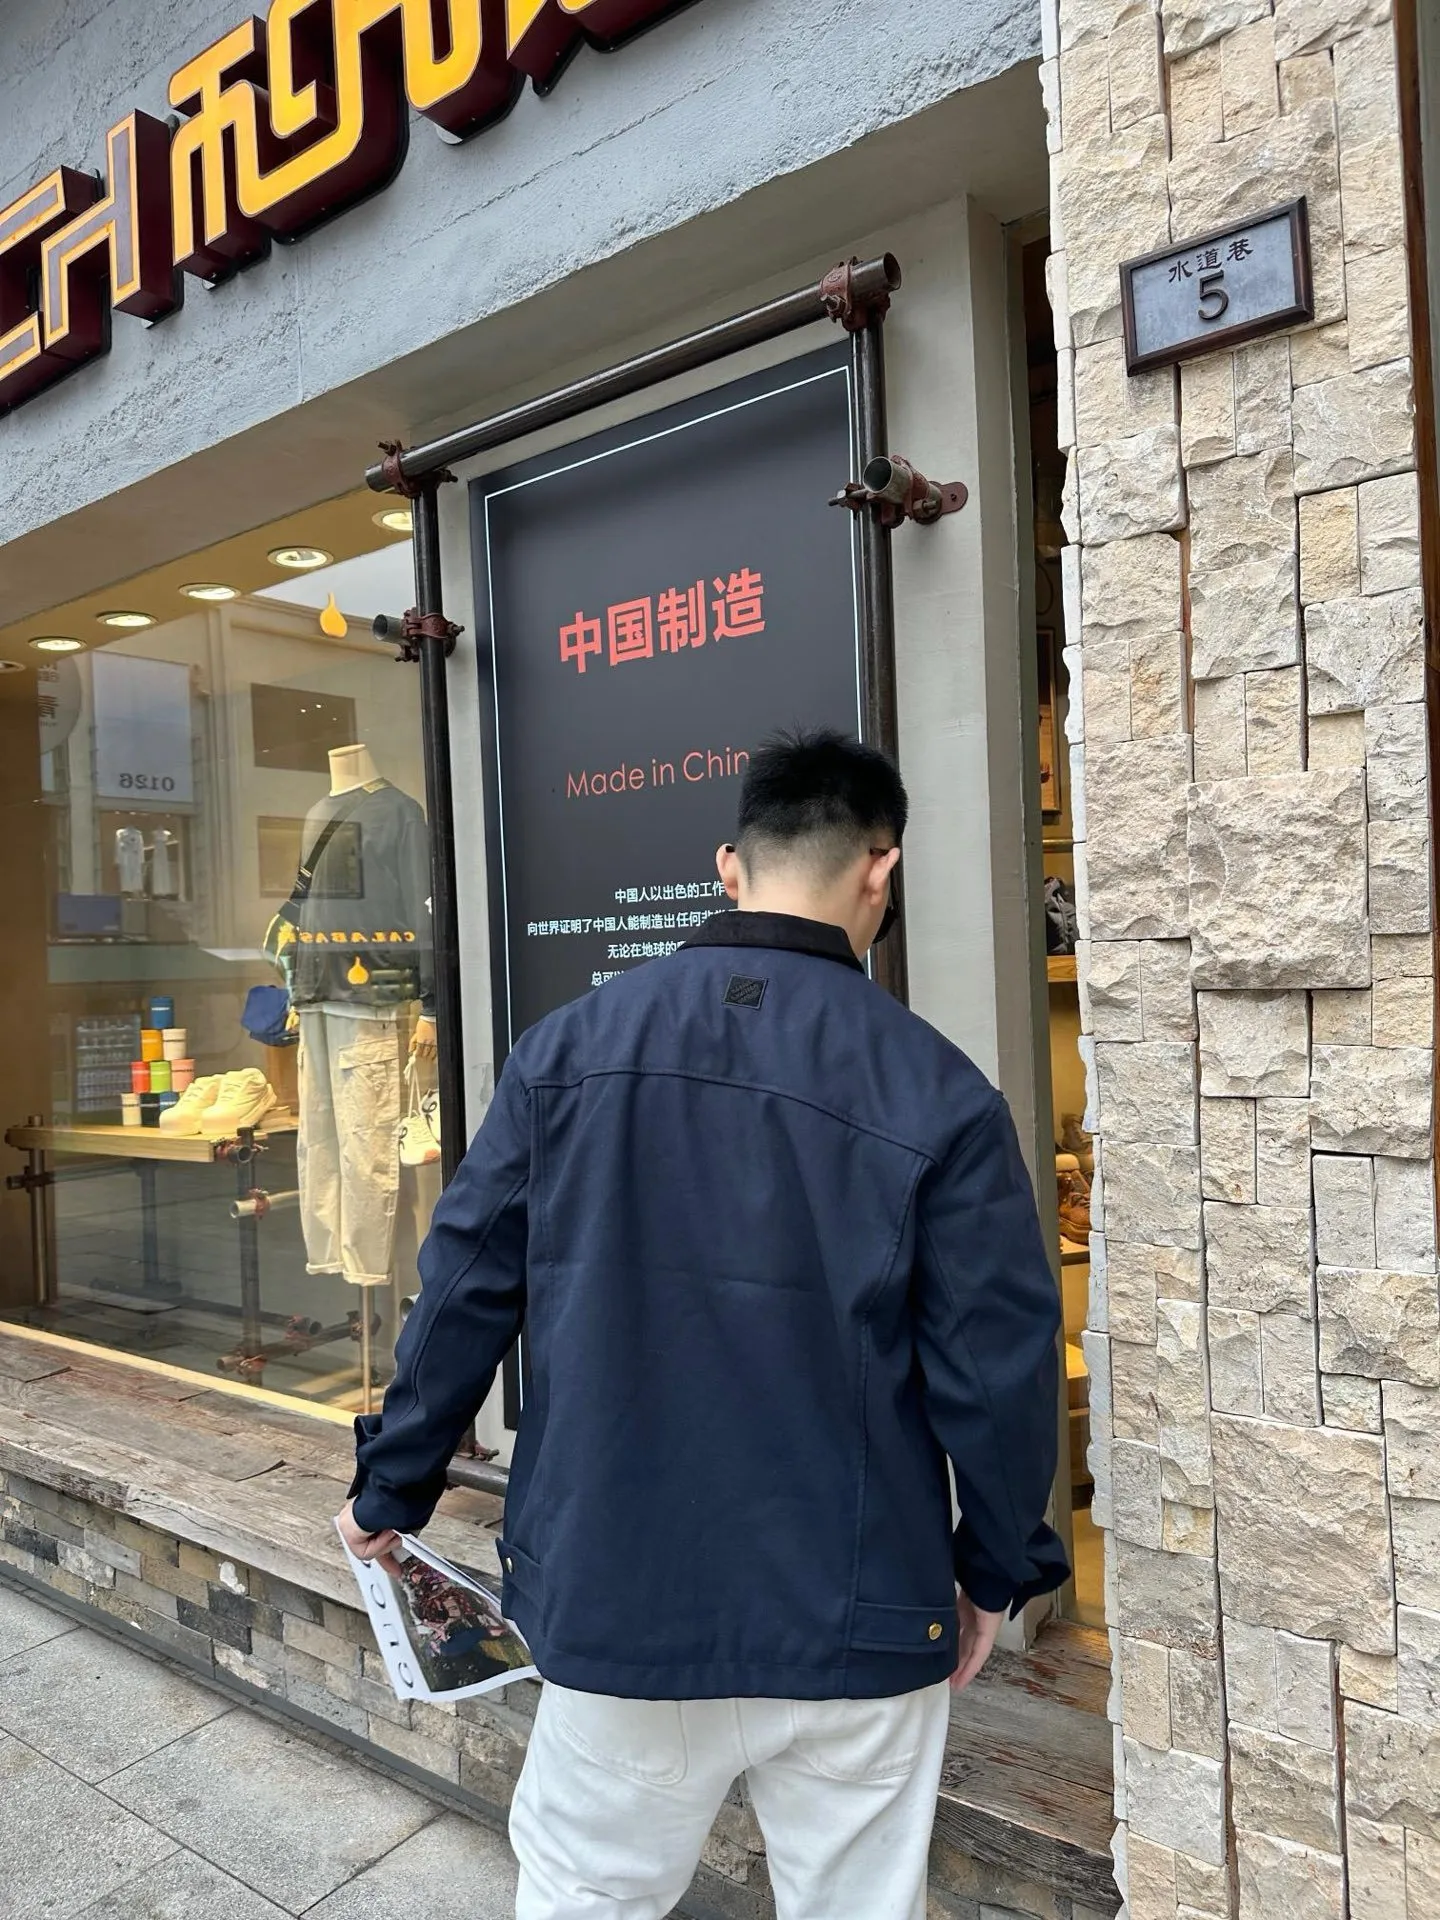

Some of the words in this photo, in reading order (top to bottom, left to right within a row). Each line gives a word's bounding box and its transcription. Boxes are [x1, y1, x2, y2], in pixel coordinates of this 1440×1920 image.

[1168, 238, 1254, 283] 水道巷
[1197, 269, 1230, 322] 5
[559, 567, 766, 674] 中国制造
[567, 763, 645, 799] Made
[651, 758, 676, 788] in
[614, 880, 726, 904] 中国人以出色的工作
